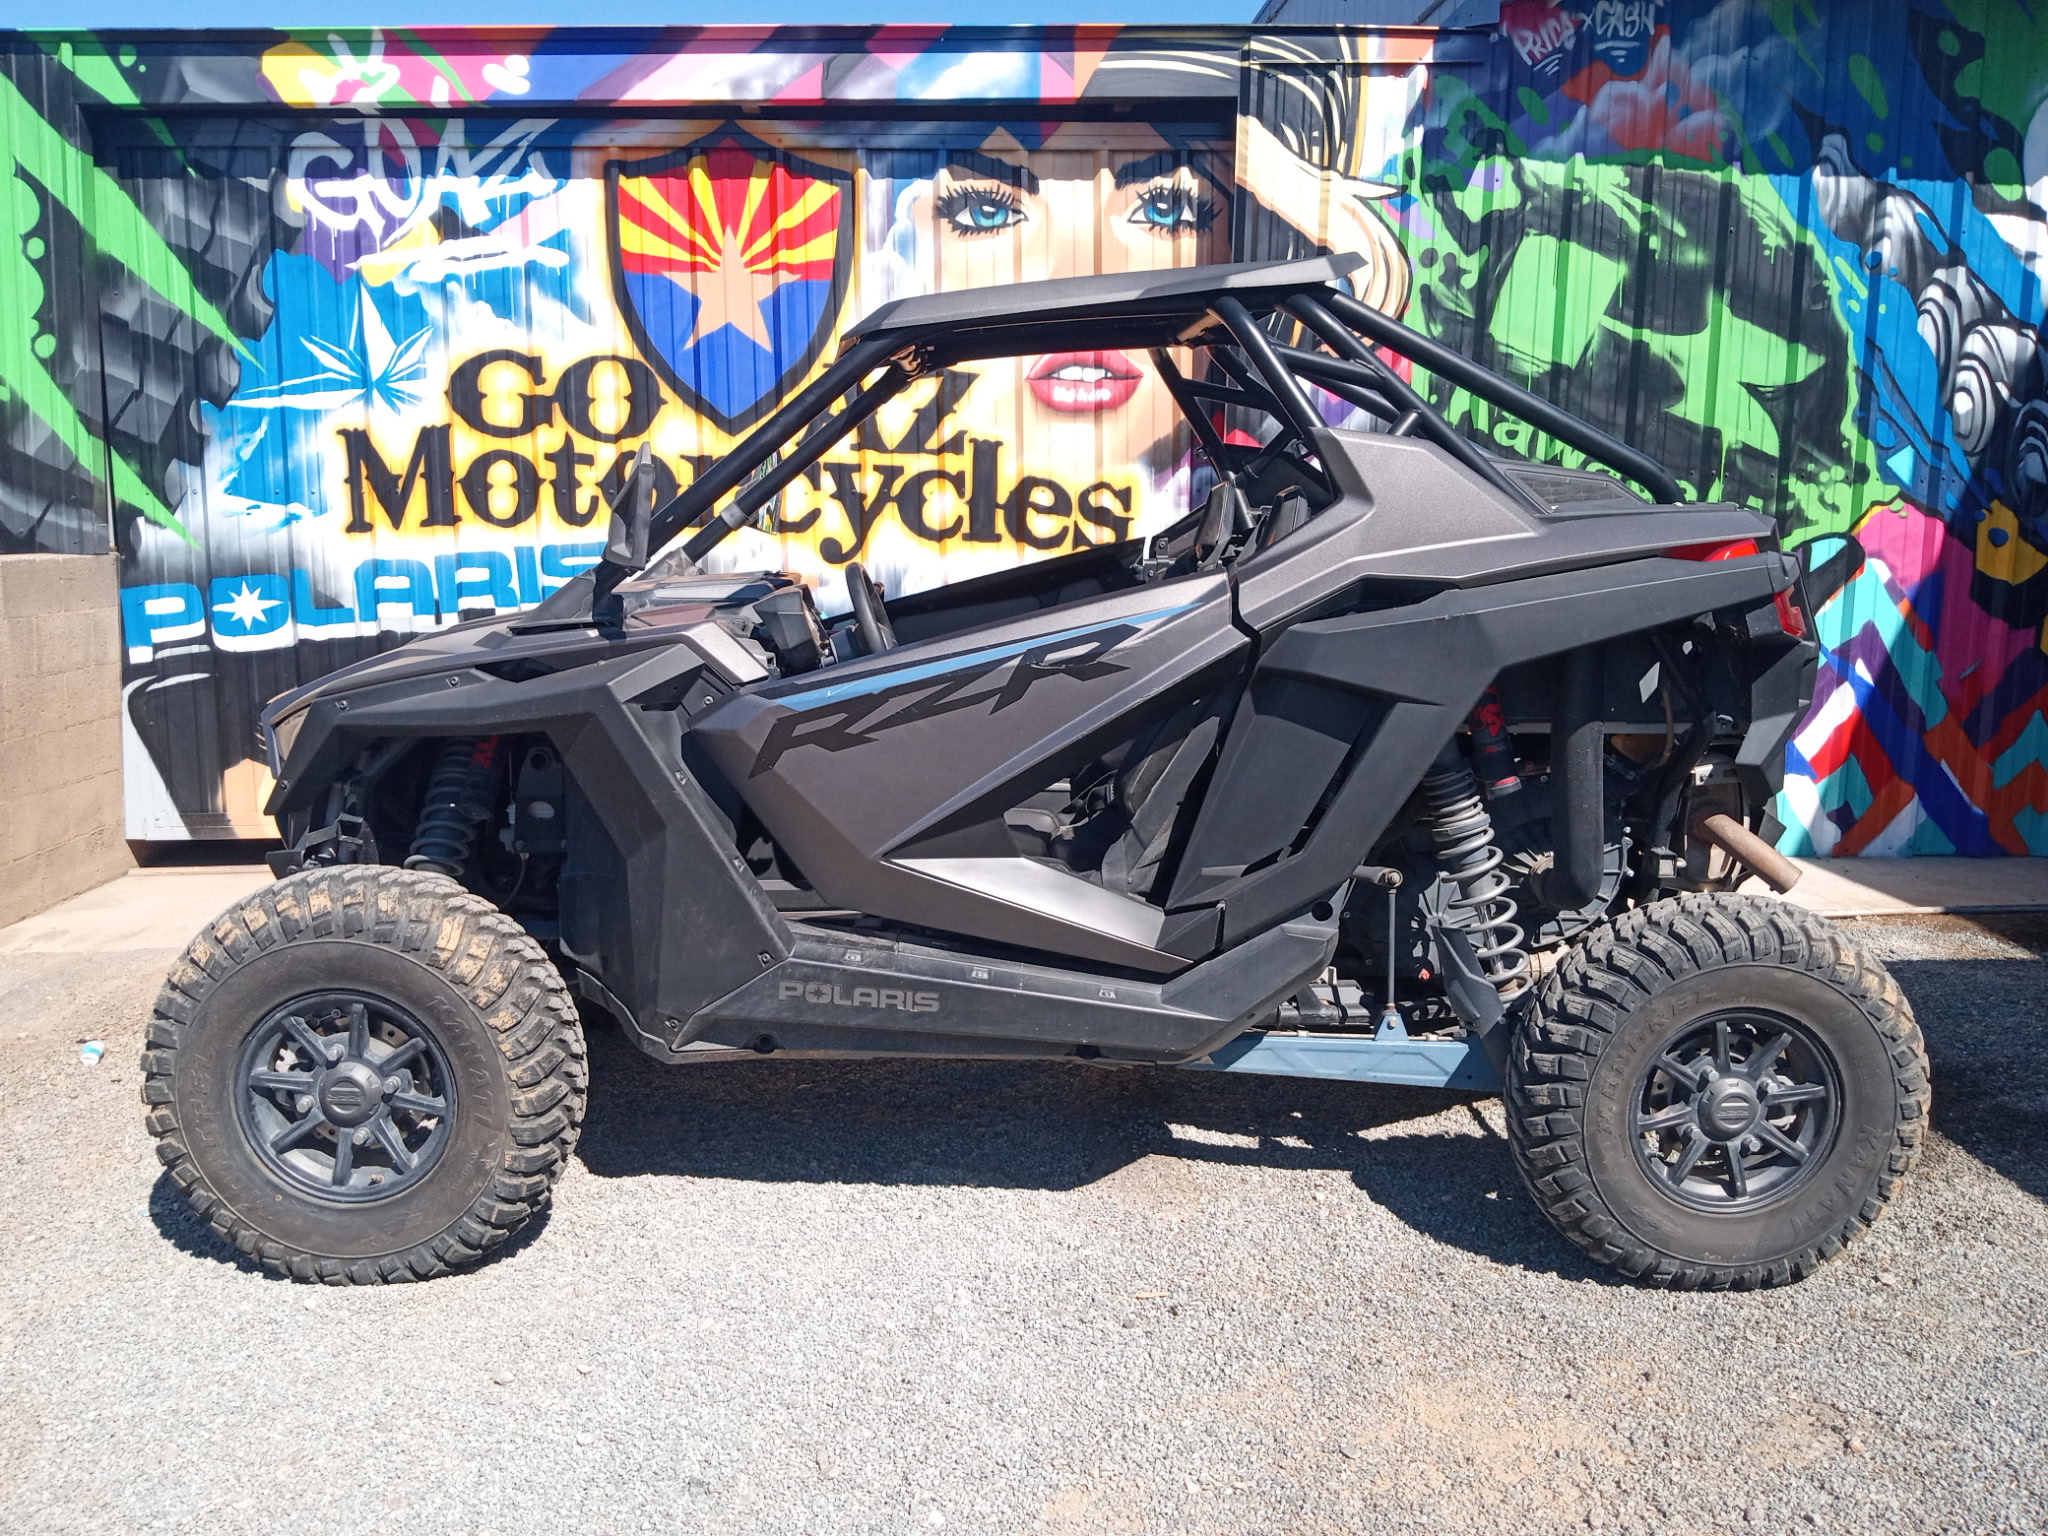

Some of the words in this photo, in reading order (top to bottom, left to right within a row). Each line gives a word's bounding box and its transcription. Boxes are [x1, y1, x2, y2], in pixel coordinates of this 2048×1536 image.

[444, 349, 668, 443] GO
[120, 541, 608, 656] POLARIS
[748, 622, 1143, 779] RZR
[778, 981, 940, 1012] POLARIS
[1790, 1123, 1883, 1235] KANATI
